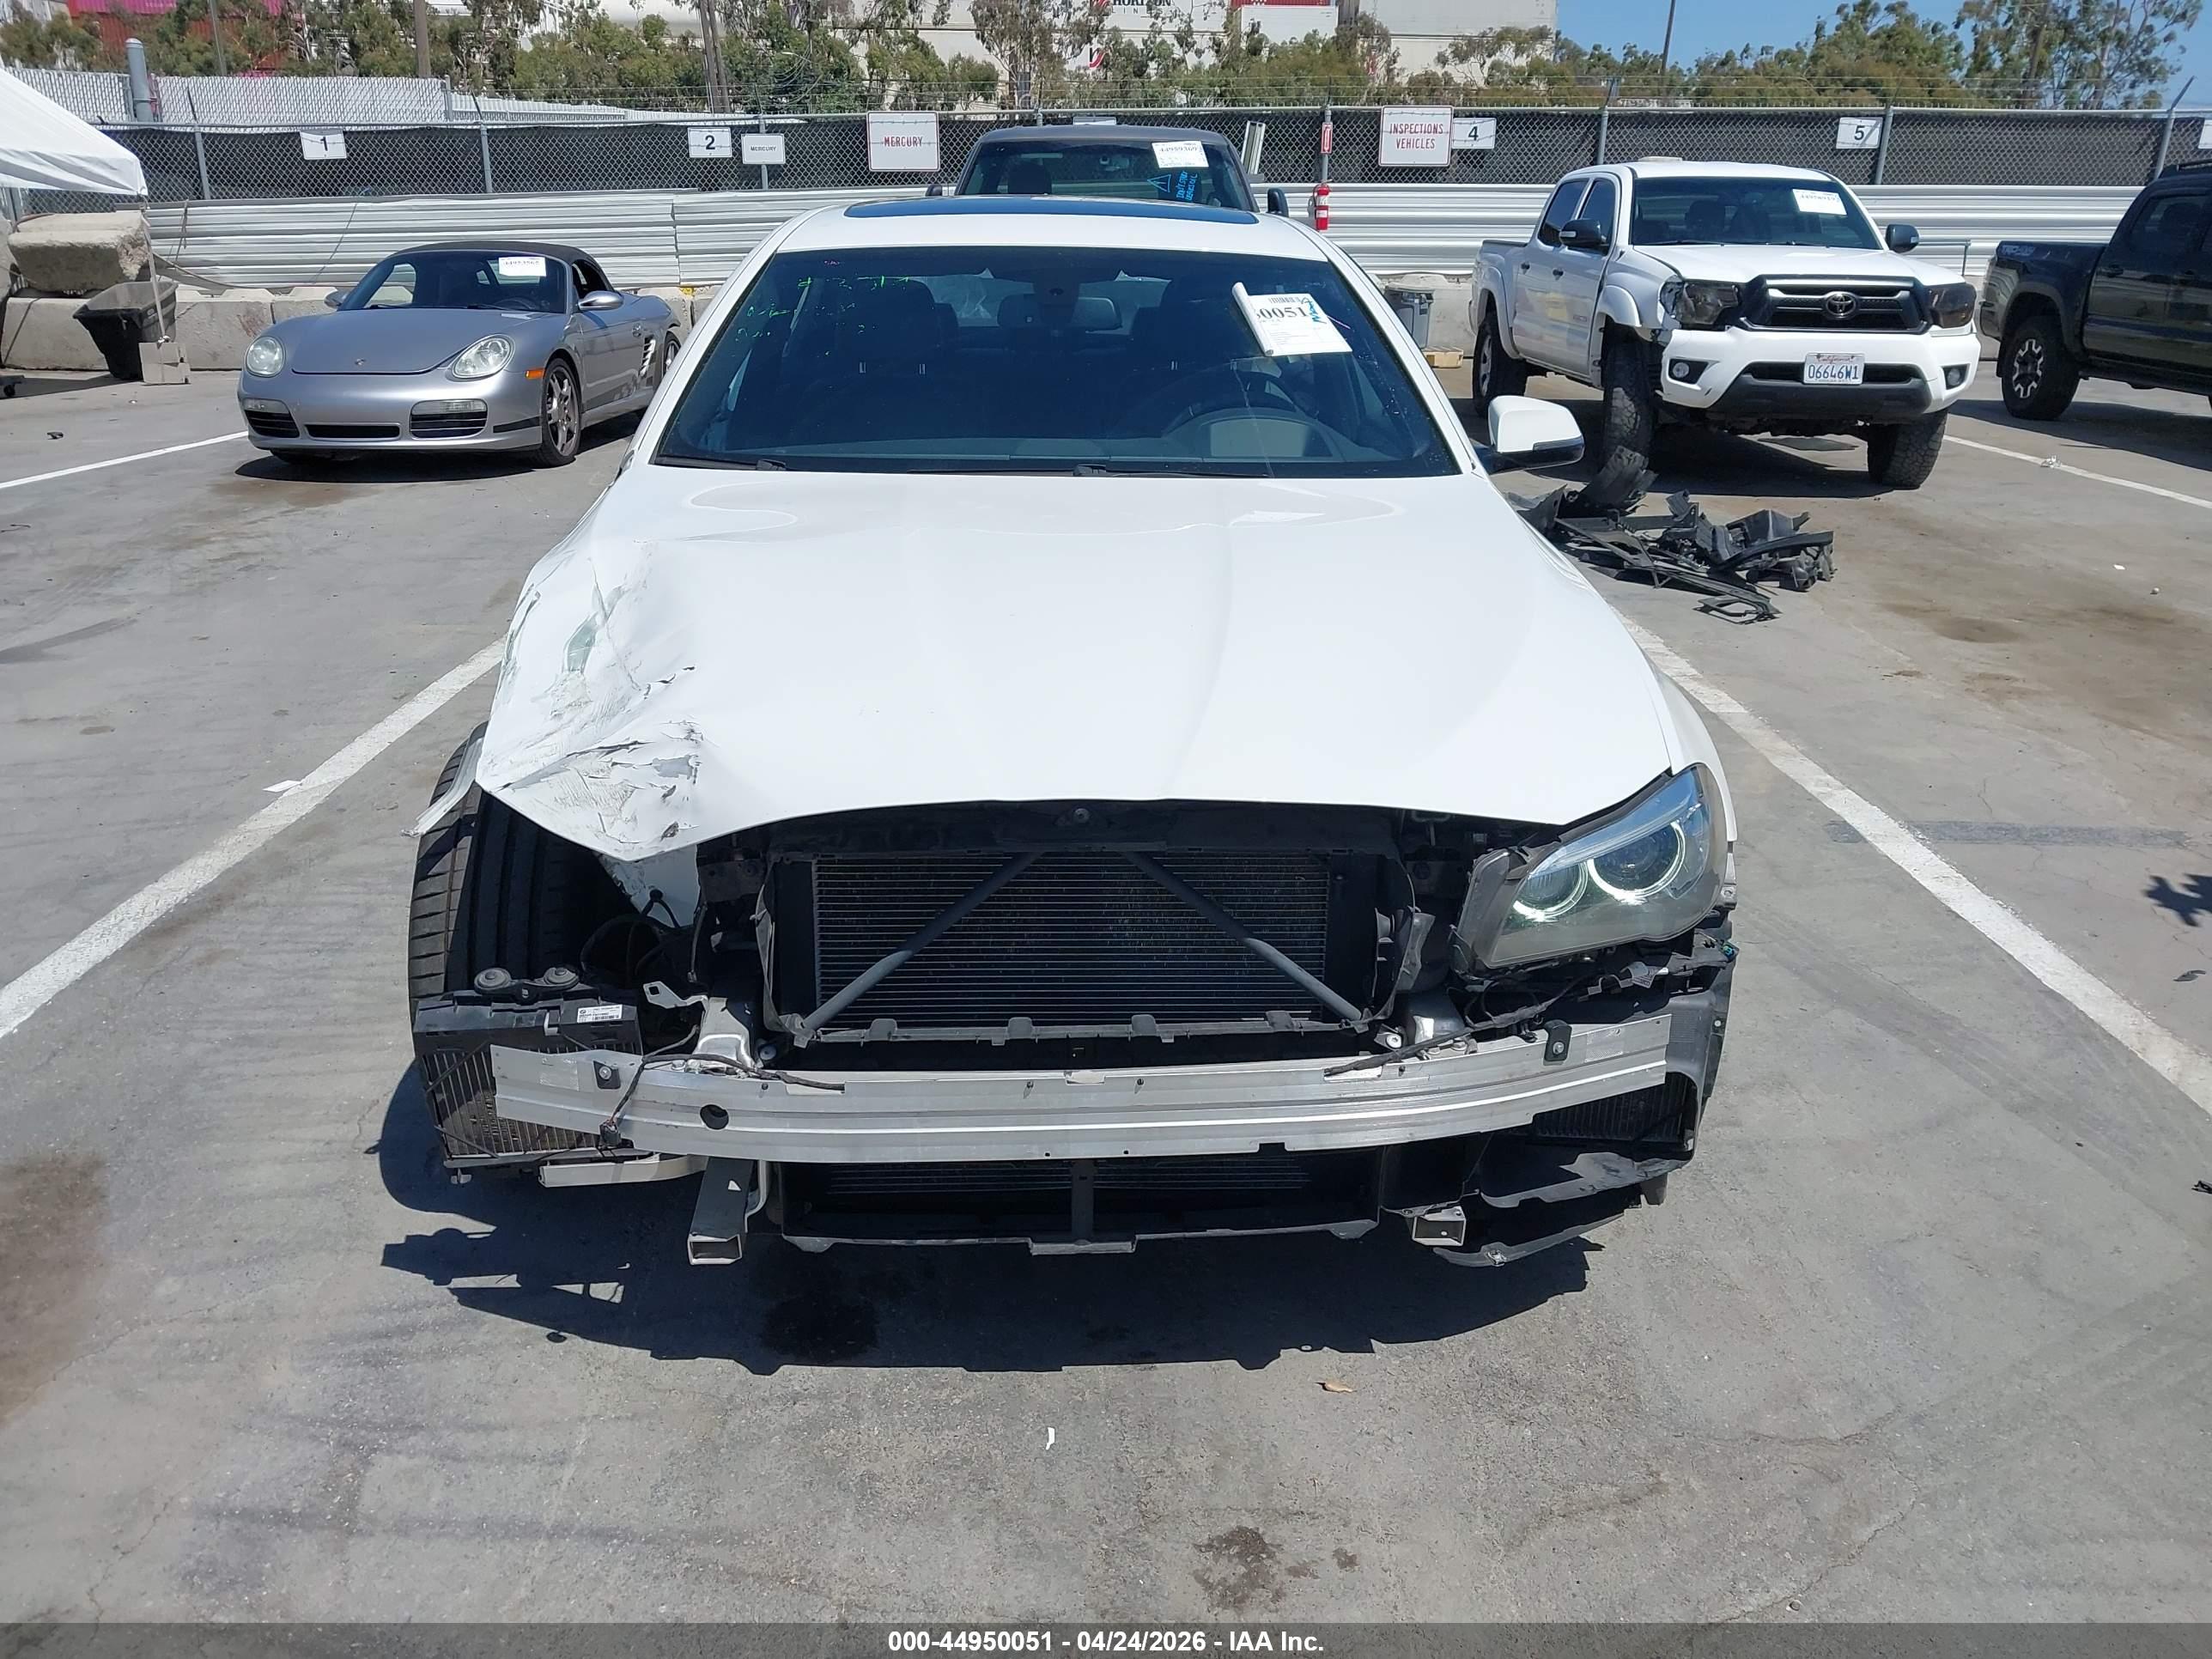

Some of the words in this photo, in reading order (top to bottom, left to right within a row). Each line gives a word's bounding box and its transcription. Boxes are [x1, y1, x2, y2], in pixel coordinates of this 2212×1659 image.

[1390, 123, 1443, 134] INSPECTIONS
[1468, 125, 1479, 141] 4
[1854, 125, 1865, 140] 5
[319, 136, 328, 151] 1
[704, 135, 715, 150] 2
[884, 136, 923, 147] MERCURY
[1396, 138, 1436, 149] VEHICLES
[1808, 364, 1859, 380] 06646W1
